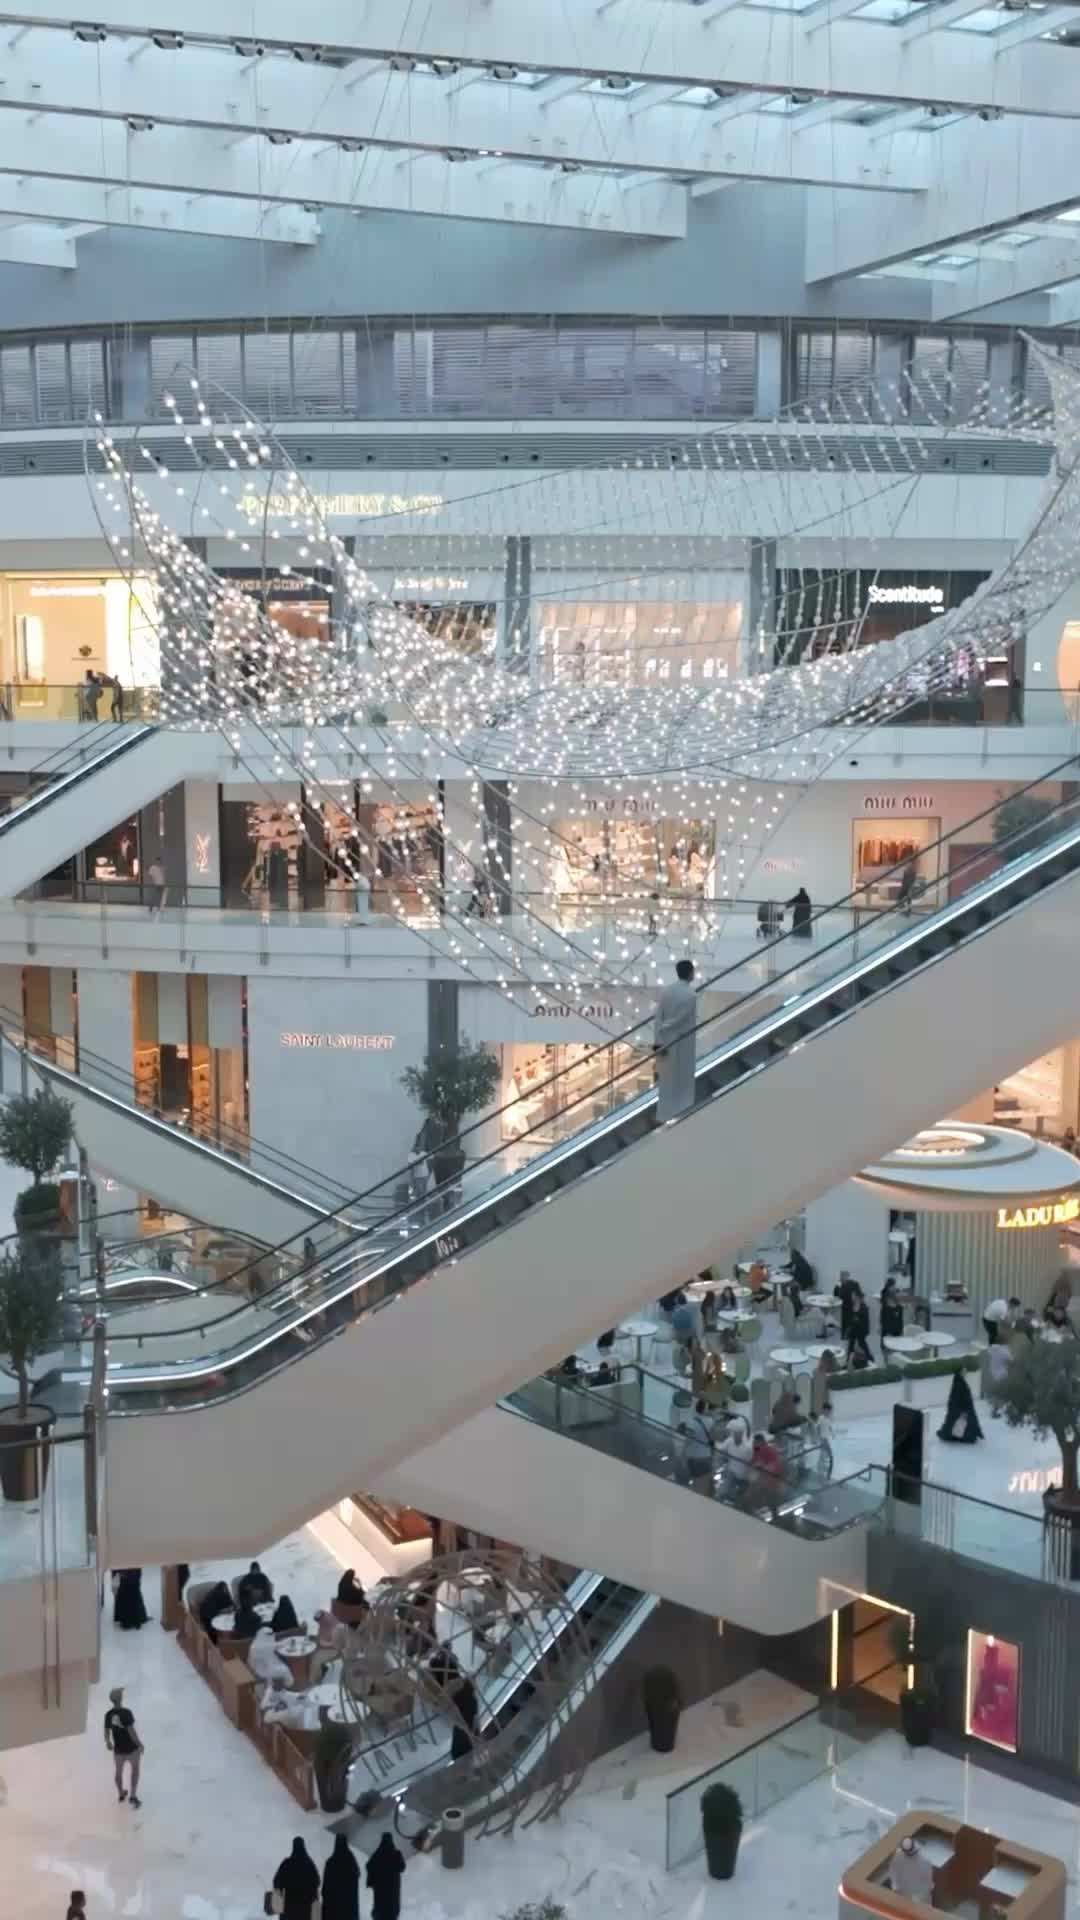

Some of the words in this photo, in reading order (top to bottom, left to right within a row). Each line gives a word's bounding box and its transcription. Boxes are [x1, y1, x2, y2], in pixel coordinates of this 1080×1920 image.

[868, 585, 943, 603] Scentitude
[281, 1032, 322, 1049] SAINT
[326, 1033, 396, 1050] LAURENT
